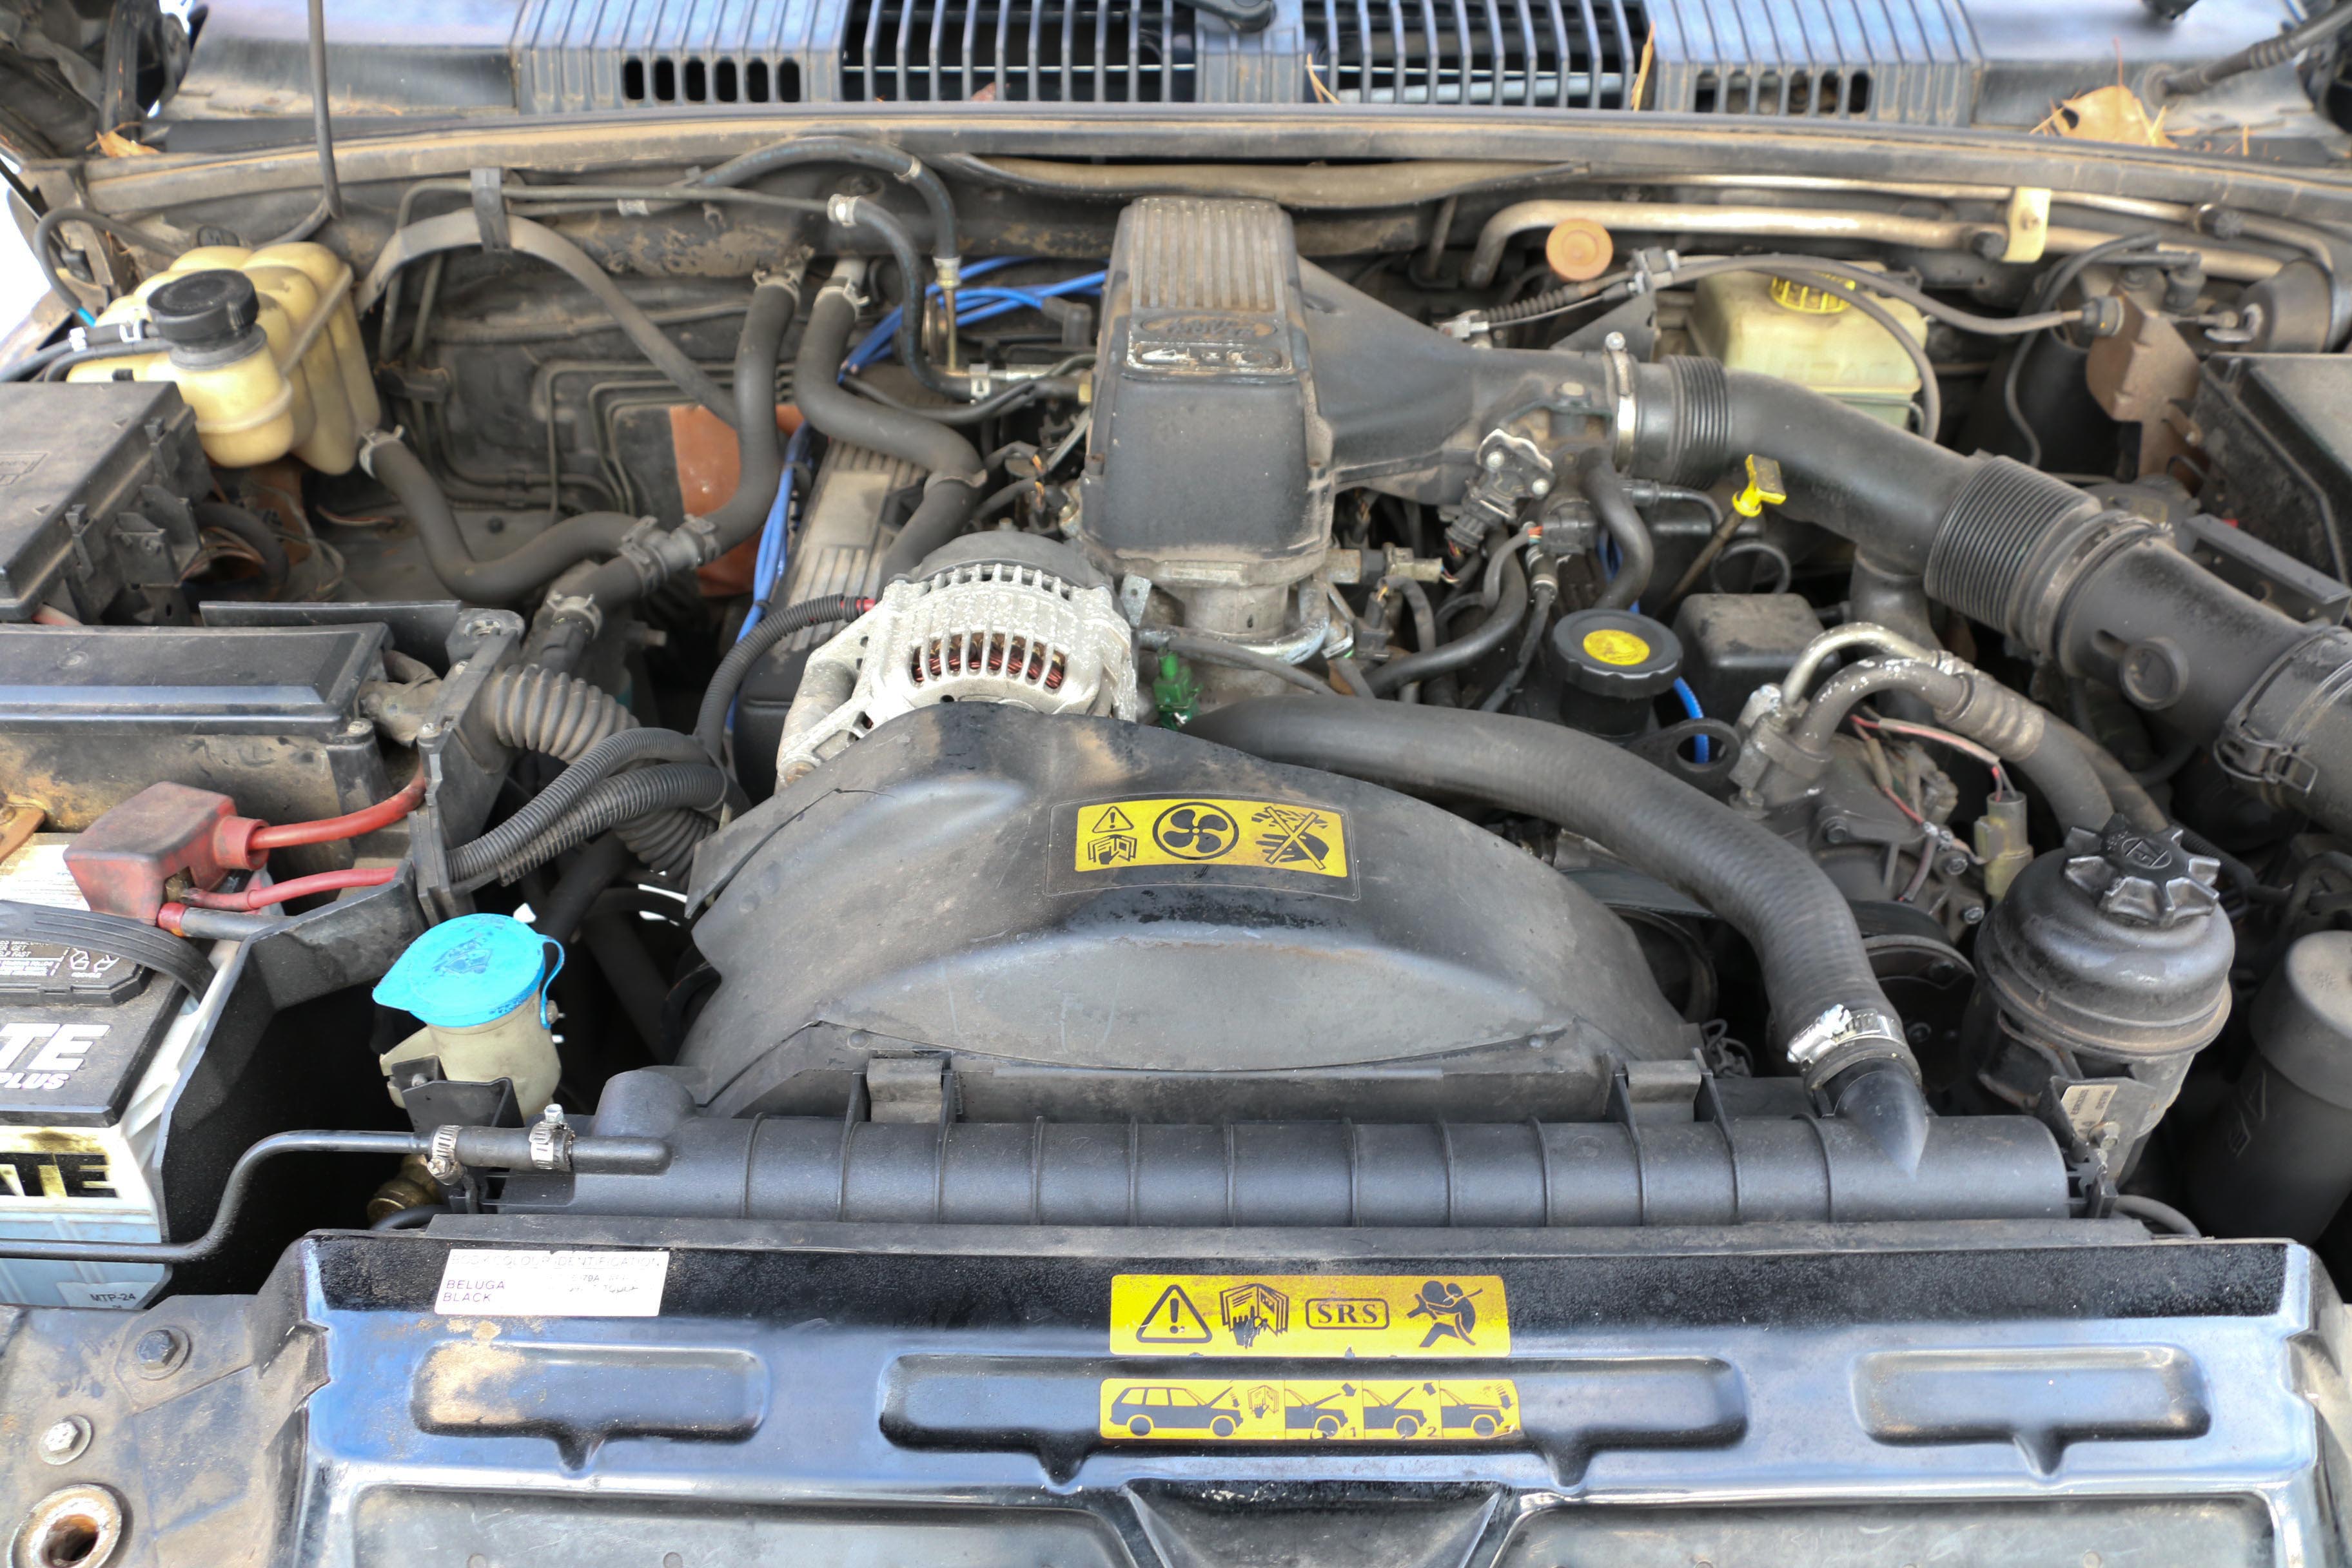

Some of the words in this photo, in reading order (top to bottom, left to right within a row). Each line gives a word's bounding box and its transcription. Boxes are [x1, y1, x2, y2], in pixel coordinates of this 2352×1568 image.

[0, 1152, 118, 1198] TE
[446, 1280, 505, 1289] BELUGA
[90, 1293, 136, 1302] MTP-24
[443, 1292, 491, 1302] BLACK
[1317, 1304, 1378, 1324] SRS
[1350, 1427, 1357, 1438] 1
[1427, 1426, 1437, 1437] 2
